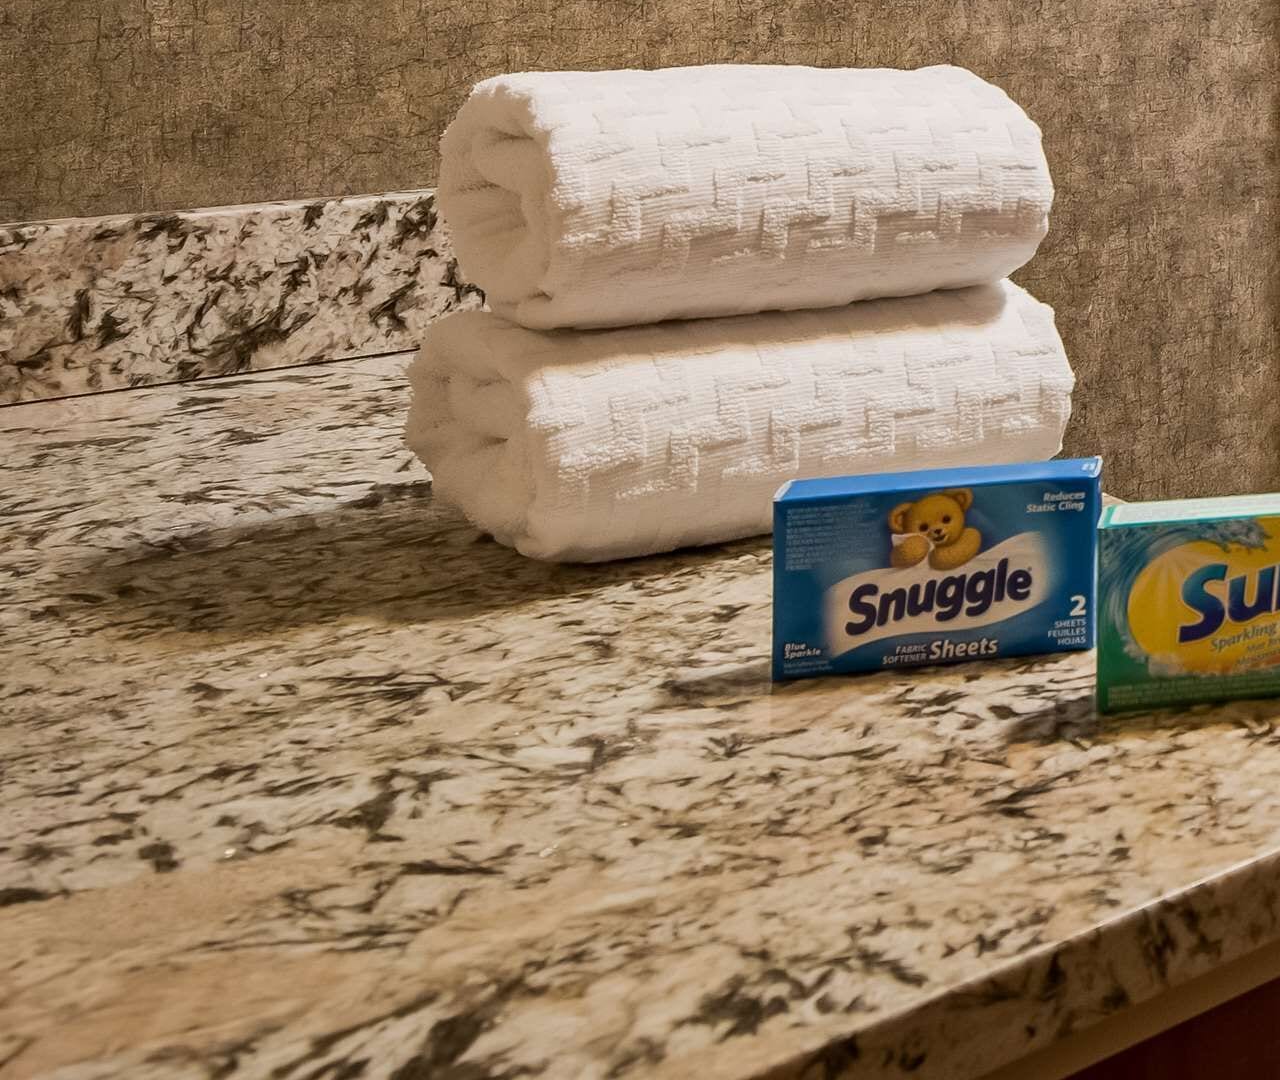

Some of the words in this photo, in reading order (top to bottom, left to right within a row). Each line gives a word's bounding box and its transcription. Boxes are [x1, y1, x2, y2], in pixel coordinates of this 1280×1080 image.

[1043, 491, 1086, 502] Reduces
[1026, 503, 1056, 513] Static
[1058, 501, 1085, 512] Cling
[845, 557, 1033, 636] Snuggle
[1070, 595, 1087, 616] 2
[1055, 618, 1087, 629] SHEETS
[1048, 627, 1087, 639] FEUILLES
[1210, 621, 1278, 653] Sparkling
[784, 642, 806, 652] Blue
[1058, 636, 1087, 646] HOJAS
[784, 648, 821, 660] Sparkle
[882, 652, 927, 666] SOFTENER
[929, 638, 998, 660] Sheets
[896, 643, 927, 655] FABRIC
